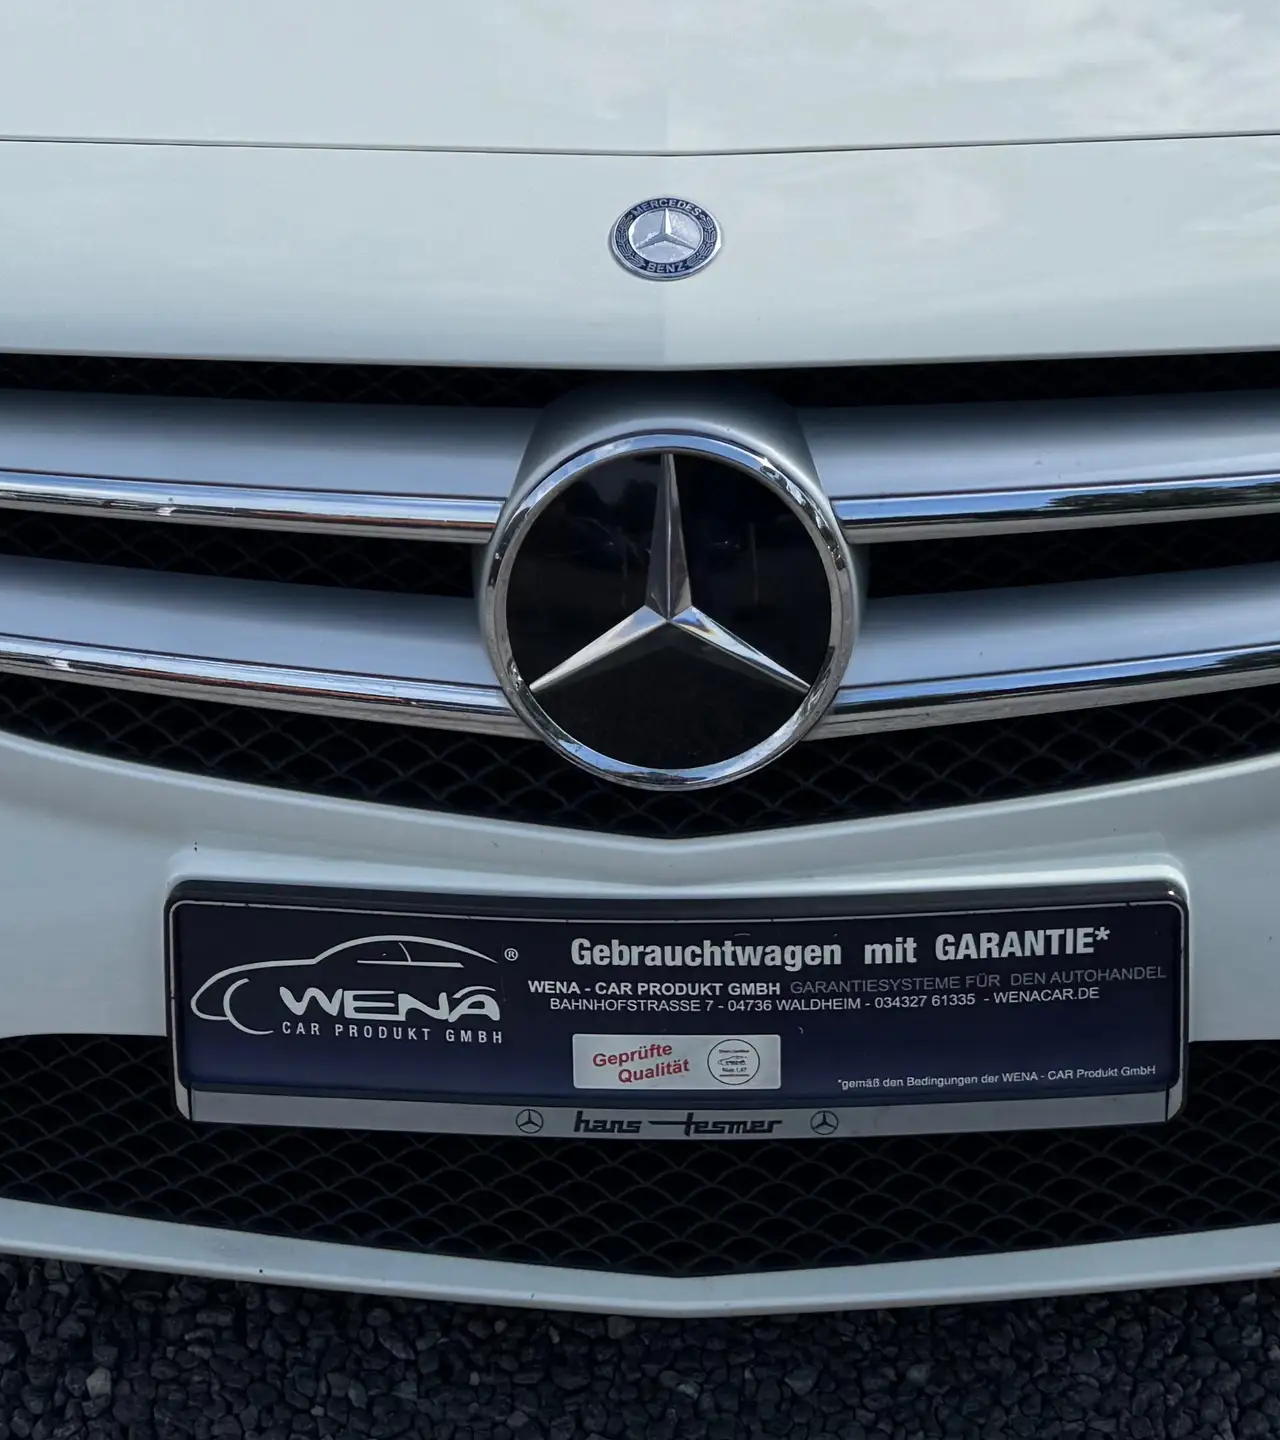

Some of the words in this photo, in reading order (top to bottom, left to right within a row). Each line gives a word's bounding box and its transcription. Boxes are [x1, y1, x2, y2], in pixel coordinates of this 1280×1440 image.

[631, 198, 702, 217] MERCEDES
[646, 262, 687, 274] BENZ
[570, 937, 842, 972] Gebrauchtwagen
[863, 936, 918, 965] mit
[527, 979, 581, 995] WENA
[594, 981, 633, 996] CAR
[637, 982, 724, 997] PRODUKT
[727, 982, 781, 996] GMBH
[789, 976, 961, 995] GARANTIESYSTEME
[965, 972, 1001, 989] FÜR
[1010, 971, 1047, 987] DEN
[1050, 965, 1167, 985] AUTOHANDEL
[278, 986, 501, 1023] WENA
[549, 997, 701, 1013] BAHNHOFSTRASSE
[704, 998, 714, 1012] 7
[727, 998, 773, 1012] 04736
[775, 996, 862, 1012] WALDHEIM
[874, 994, 927, 1010] 034327
[931, 993, 976, 1008] 61335
[993, 986, 1100, 1005] WENACAR.DE
[281, 1021, 321, 1036] CAR
[334, 1024, 432, 1042] PRODUKT
[444, 1028, 503, 1045] GMBH
[592, 1043, 673, 1068] Geprüfte
[617, 1058, 690, 1084] Qualität
[882, 1076, 904, 1088] den
[906, 1074, 978, 1088] Bedingungen
[980, 1073, 1000, 1085] der
[1001, 1071, 1039, 1083] WENA
[1047, 1069, 1074, 1081] CAR
[1076, 1066, 1119, 1079] Produkt
[1120, 1065, 1157, 1077] GmbH
[573, 1109, 643, 1134] hans
[646, 1111, 783, 1137] tesmer
